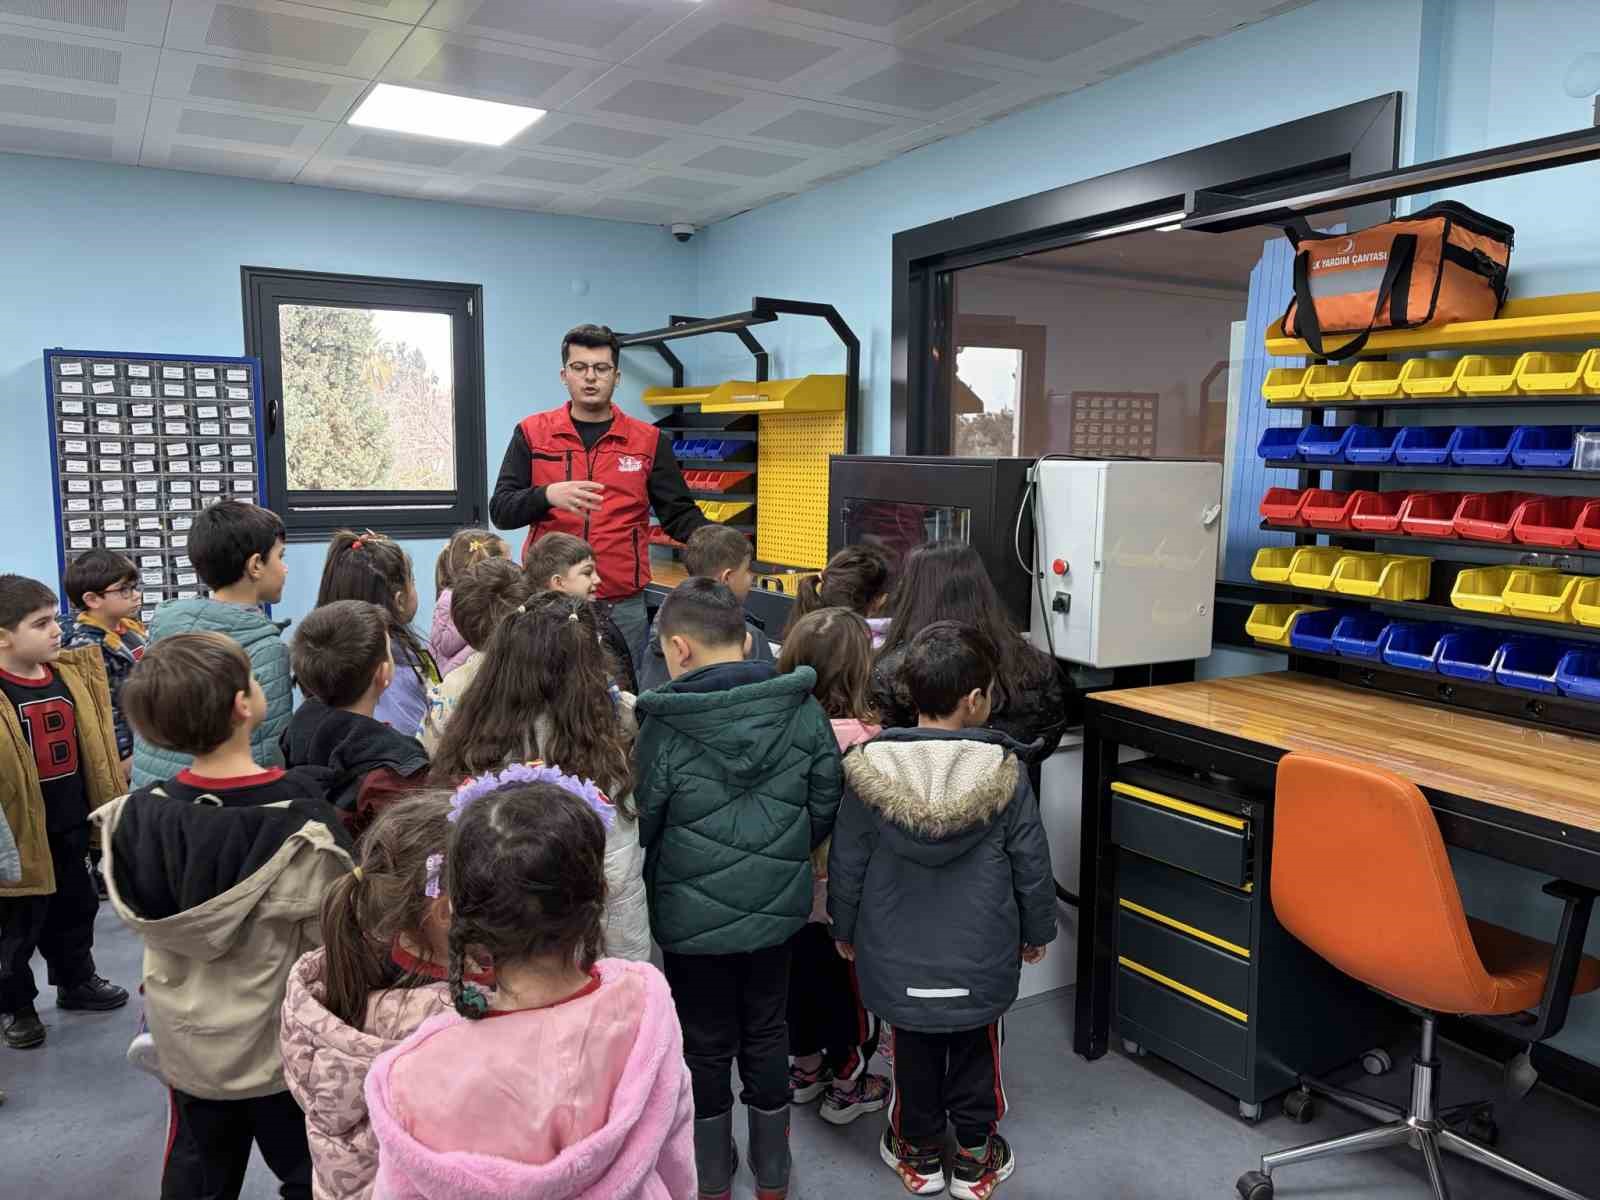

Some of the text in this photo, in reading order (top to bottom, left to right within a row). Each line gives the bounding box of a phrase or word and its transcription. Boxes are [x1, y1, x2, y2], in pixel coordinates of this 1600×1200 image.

[1321, 256, 1350, 268] YARDIM
[1352, 251, 1388, 266] ÇANTASI
[18, 695, 79, 782] B
